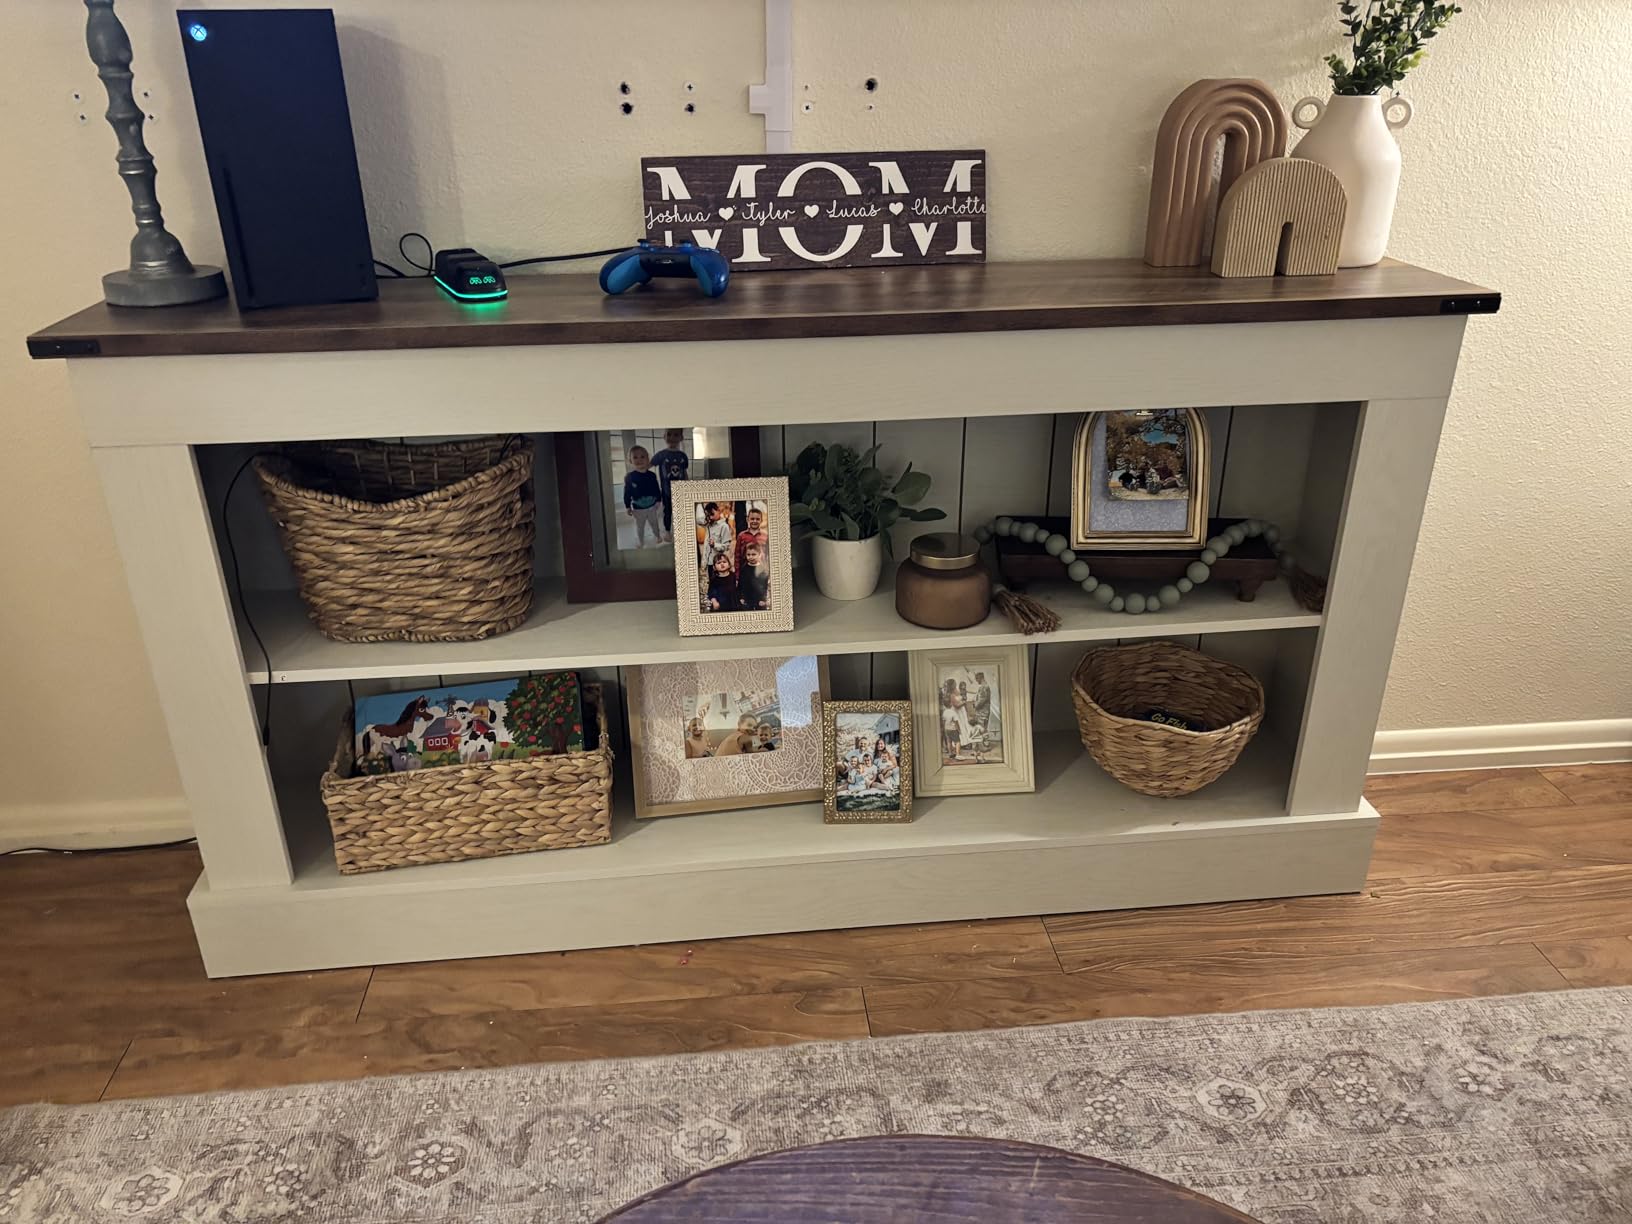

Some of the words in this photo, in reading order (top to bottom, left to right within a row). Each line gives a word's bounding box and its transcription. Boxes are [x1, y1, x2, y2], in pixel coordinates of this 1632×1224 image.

[645, 203, 711, 230] Joshua
[741, 201, 796, 226] Tyler
[826, 199, 882, 218] Lucas
[910, 196, 987, 215] Charlotte
[646, 159, 983, 263] MOM
[1151, 713, 1165, 722] Go
